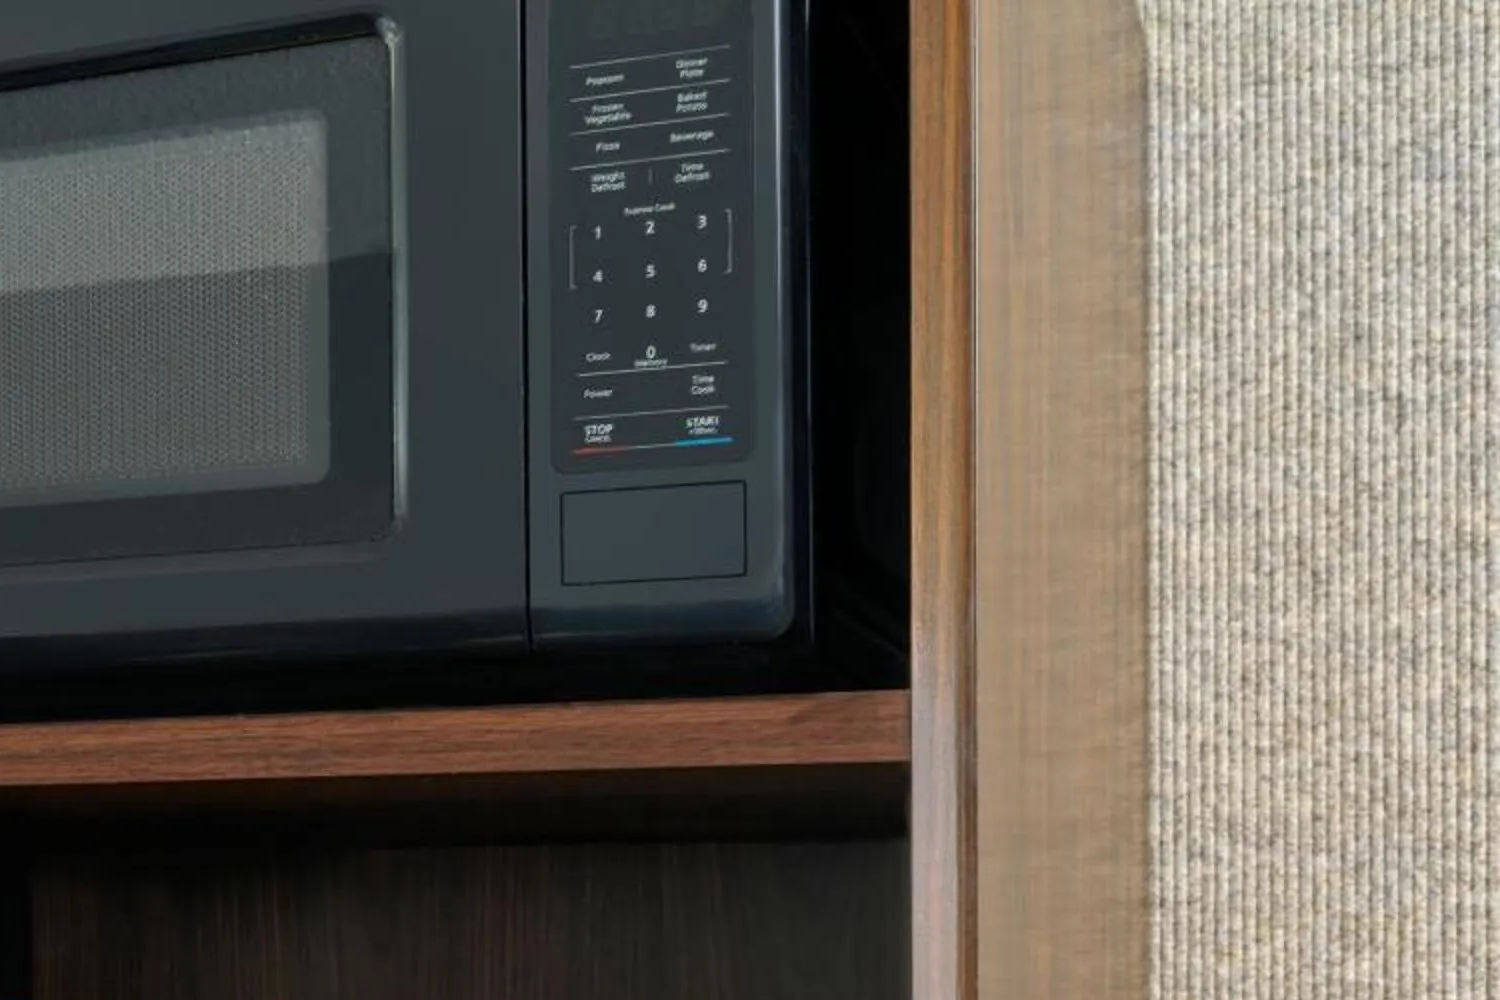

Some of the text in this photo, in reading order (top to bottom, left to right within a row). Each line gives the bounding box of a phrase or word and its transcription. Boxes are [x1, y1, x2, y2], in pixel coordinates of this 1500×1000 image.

[594, 215, 707, 239] 1 2 3
[593, 259, 707, 282] 4 5 6
[594, 299, 708, 323] 7 8 9
[646, 345, 656, 359] 0
[584, 424, 613, 435] STOP
